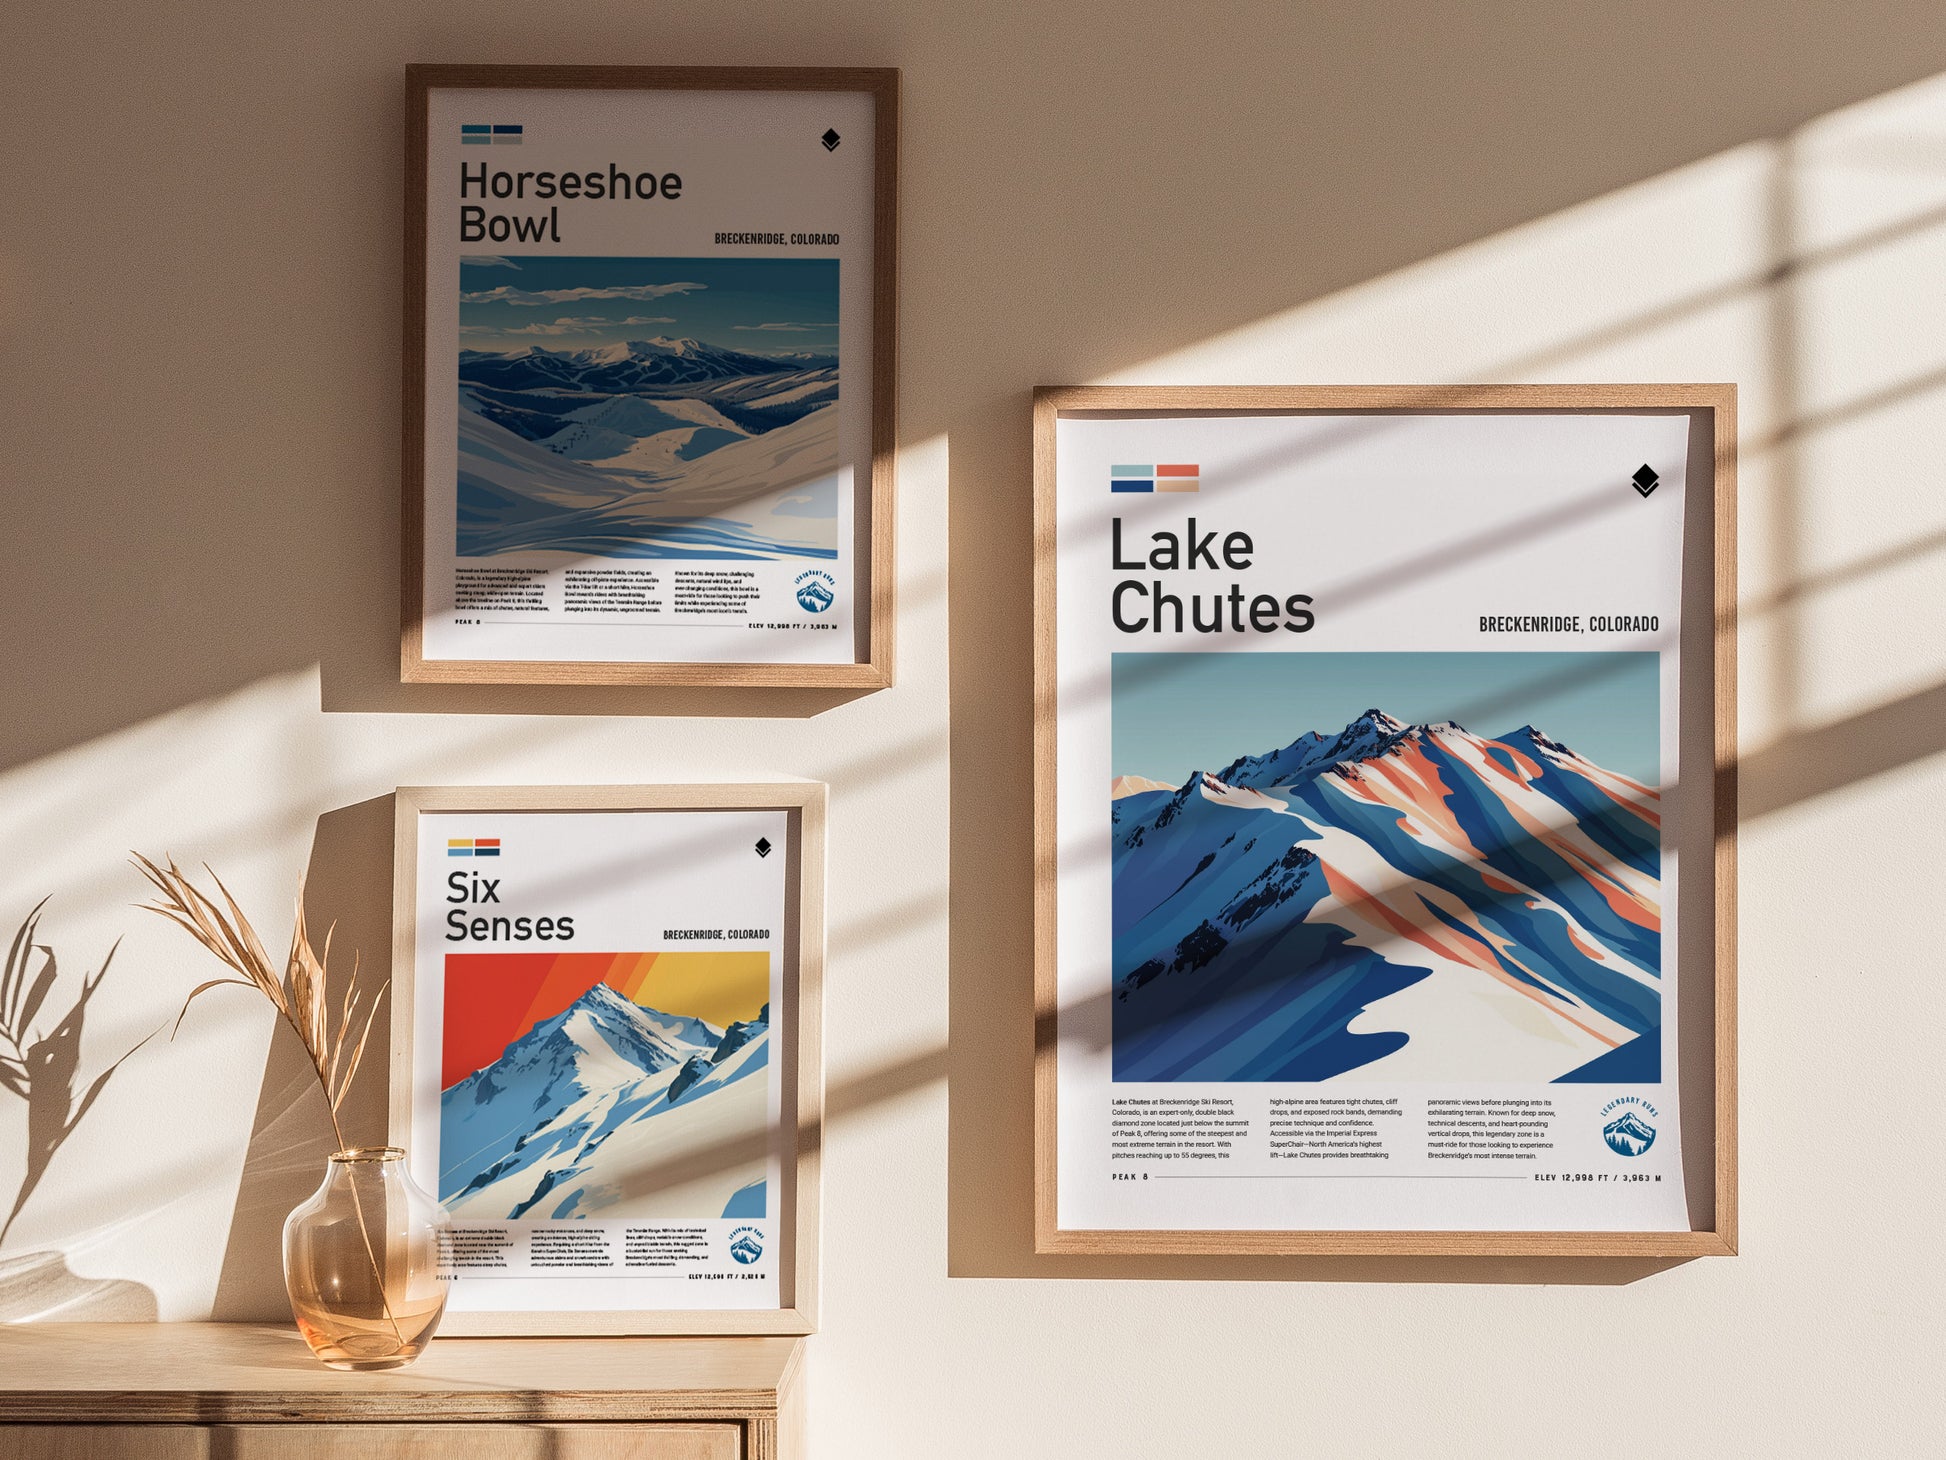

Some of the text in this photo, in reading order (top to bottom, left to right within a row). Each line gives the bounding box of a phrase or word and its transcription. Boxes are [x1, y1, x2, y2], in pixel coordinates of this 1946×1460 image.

[460, 161, 683, 200] Horseshoe
[460, 205, 561, 243] Bowl
[714, 232, 840, 246] BRECKENRIDGE, COLORADO
[1111, 517, 1254, 571] Lake
[1112, 579, 1315, 634] Chutes
[1479, 616, 1659, 634] BRECKENRIDGE, COLORADO
[446, 870, 501, 904] Six
[444, 908, 575, 942] Senses
[664, 930, 770, 940] BRECKENRIDGE, COLORADO
[1600, 1096, 1658, 1118] LEGENDARY RUNS
[1534, 1173, 1557, 1182] ELEV
[1561, 1173, 1594, 1183] 12,998
[1622, 1174, 1650, 1183] 3,963
